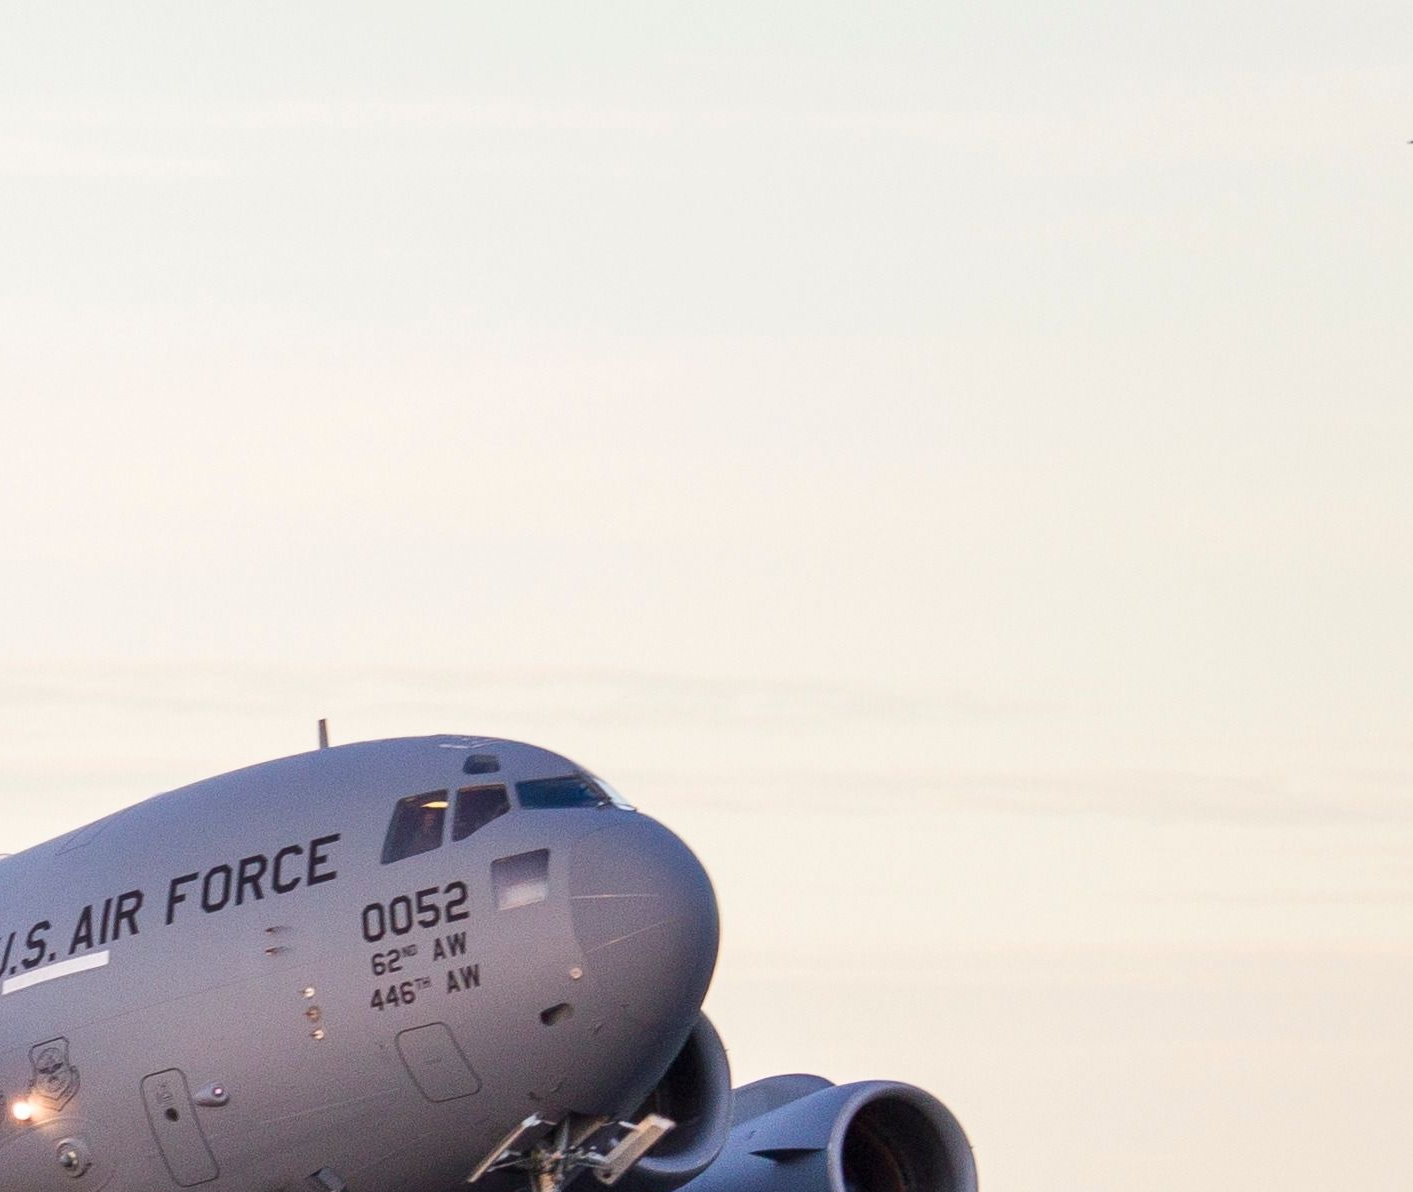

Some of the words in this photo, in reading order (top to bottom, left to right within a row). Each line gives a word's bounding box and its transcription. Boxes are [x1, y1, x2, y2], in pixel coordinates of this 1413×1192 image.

[68, 889, 144, 955] AIR
[165, 833, 341, 925] FORCE
[362, 881, 470, 943] 0052
[433, 931, 467, 961] AW
[447, 964, 481, 994] AW
